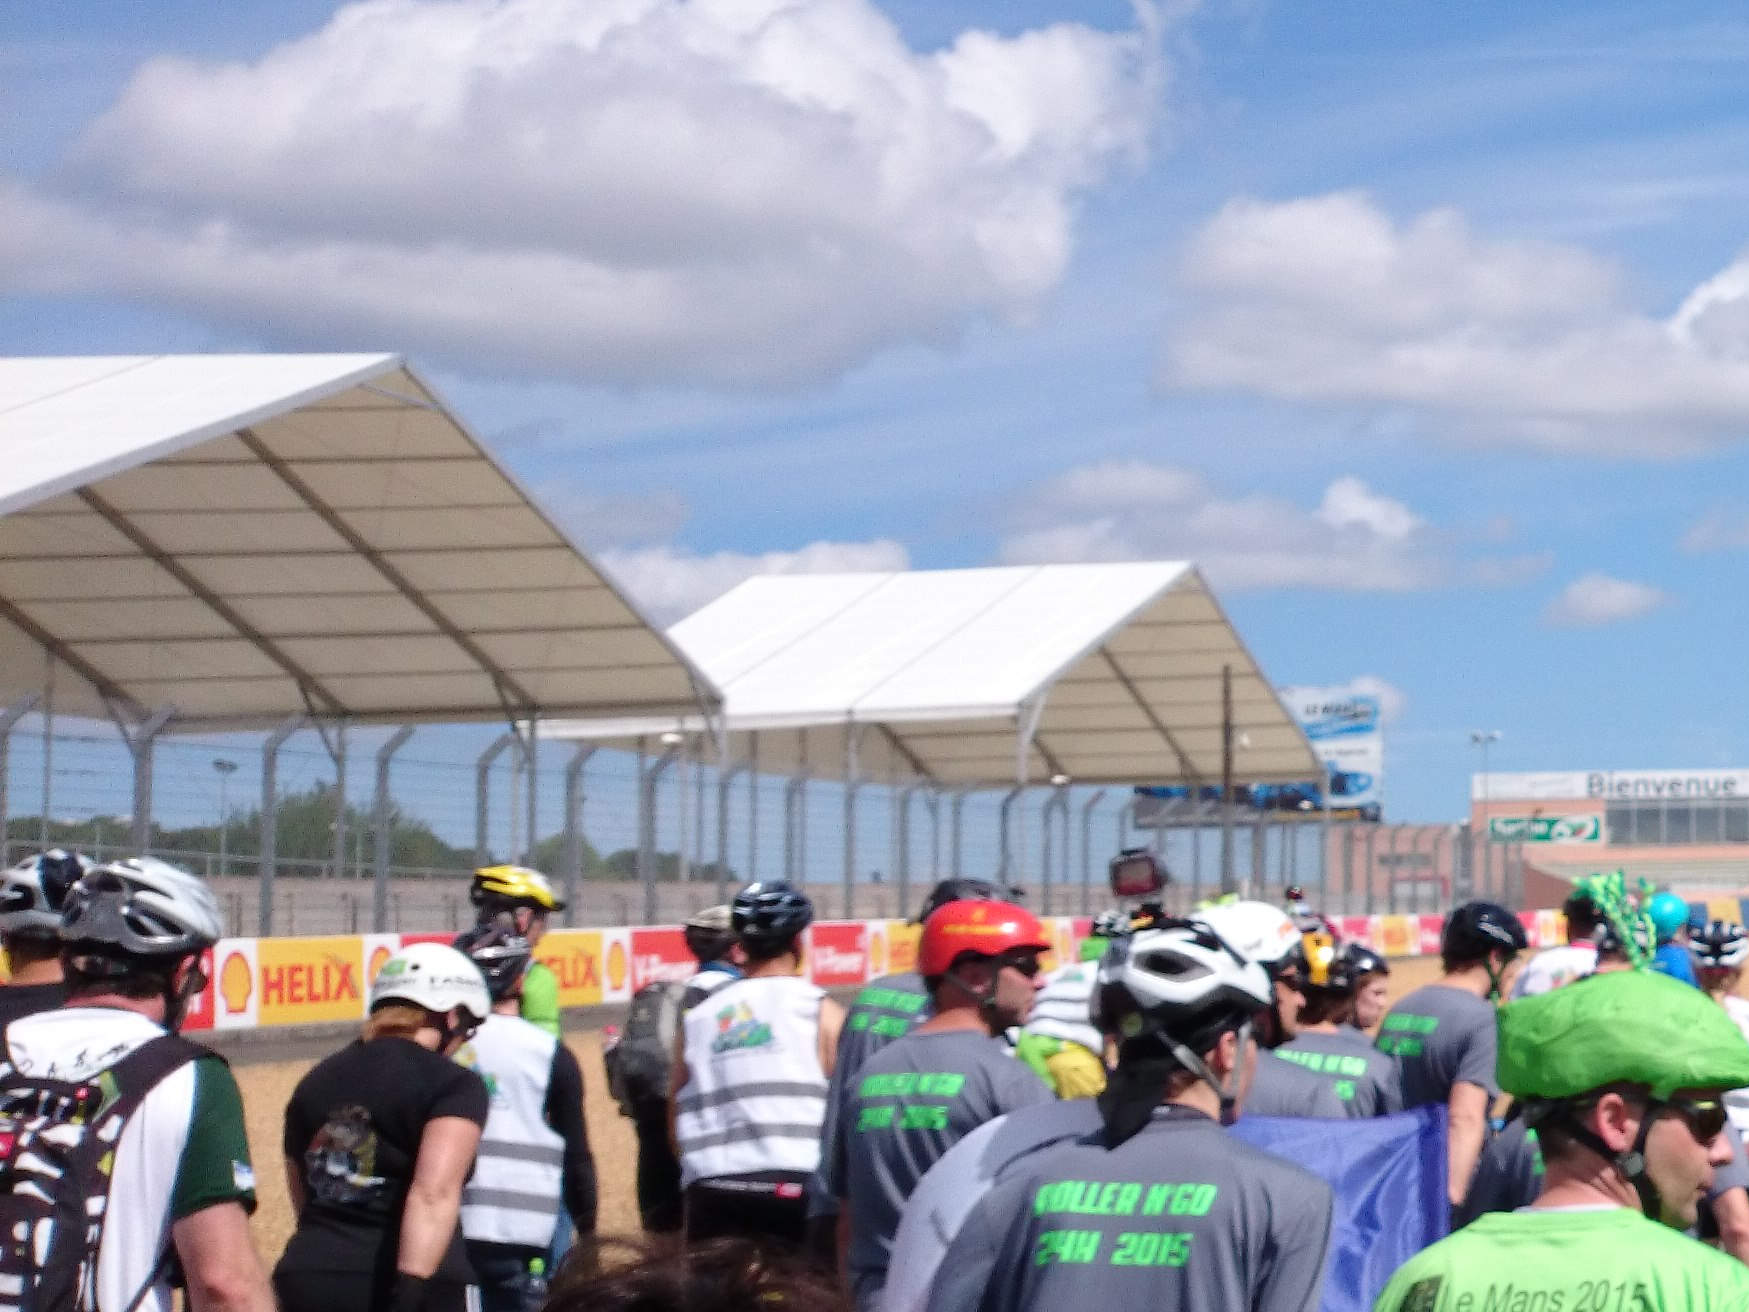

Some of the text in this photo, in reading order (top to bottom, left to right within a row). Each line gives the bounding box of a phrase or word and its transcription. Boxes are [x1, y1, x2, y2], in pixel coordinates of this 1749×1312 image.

[1586, 771, 1738, 798] Bienvenue
[262, 963, 361, 1006] HELIX
[1034, 1180, 1143, 1216] ROLLER
[1034, 1229, 1195, 1267] 24H 2015
